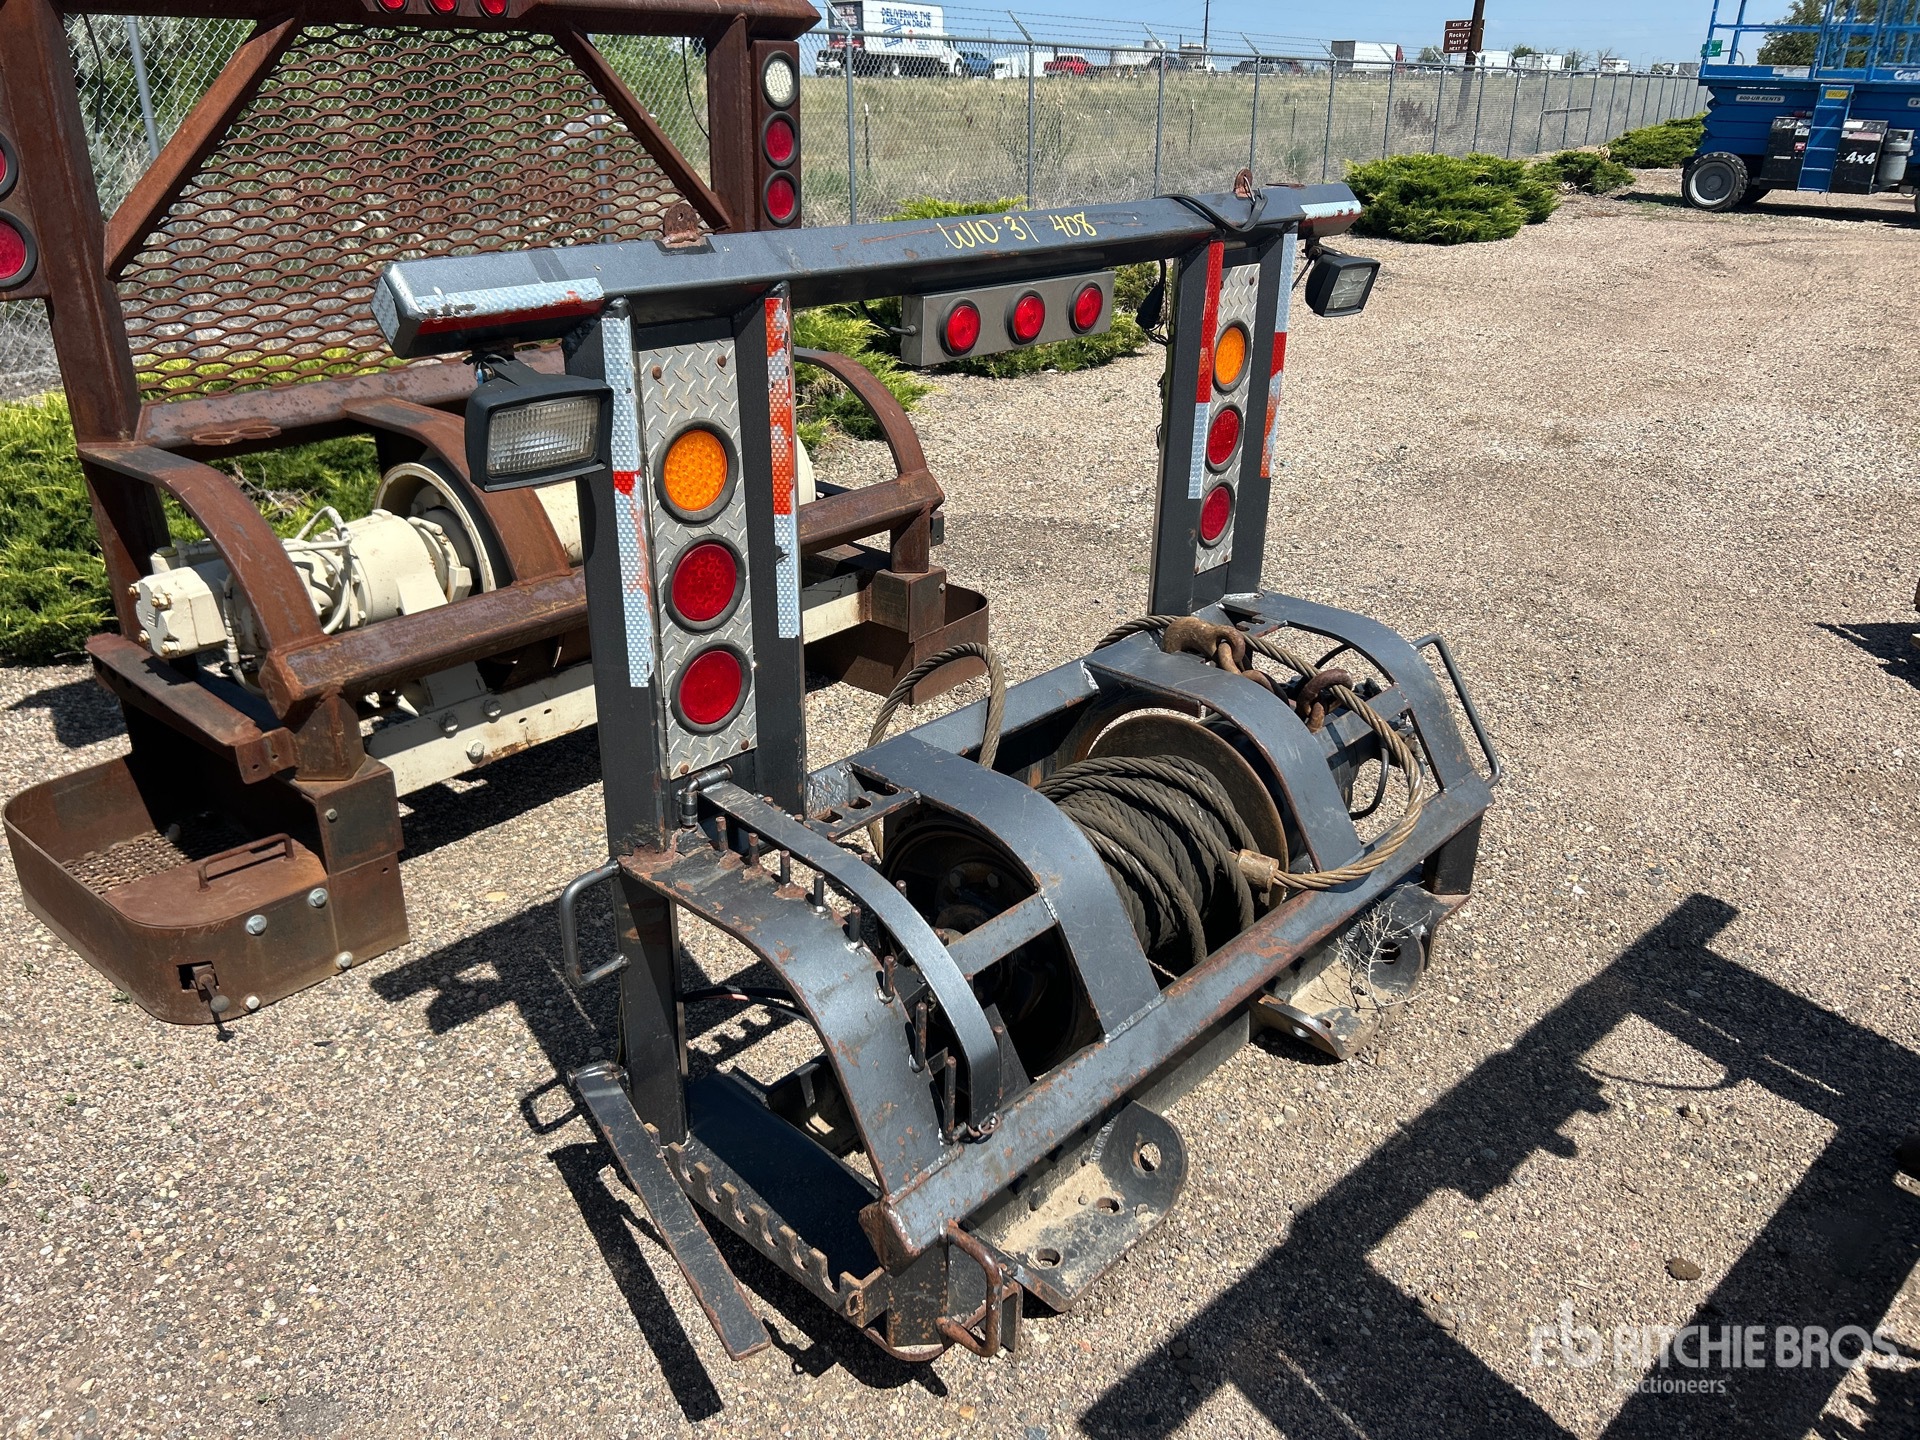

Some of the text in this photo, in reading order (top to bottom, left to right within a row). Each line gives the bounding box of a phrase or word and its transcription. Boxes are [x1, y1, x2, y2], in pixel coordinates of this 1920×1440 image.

[881, 7, 931, 21] DELIVERING THE
[881, 17, 931, 28] AMERICAN DREAM
[1845, 151, 1877, 165] 4x4
[1048, 211, 1097, 238] 408
